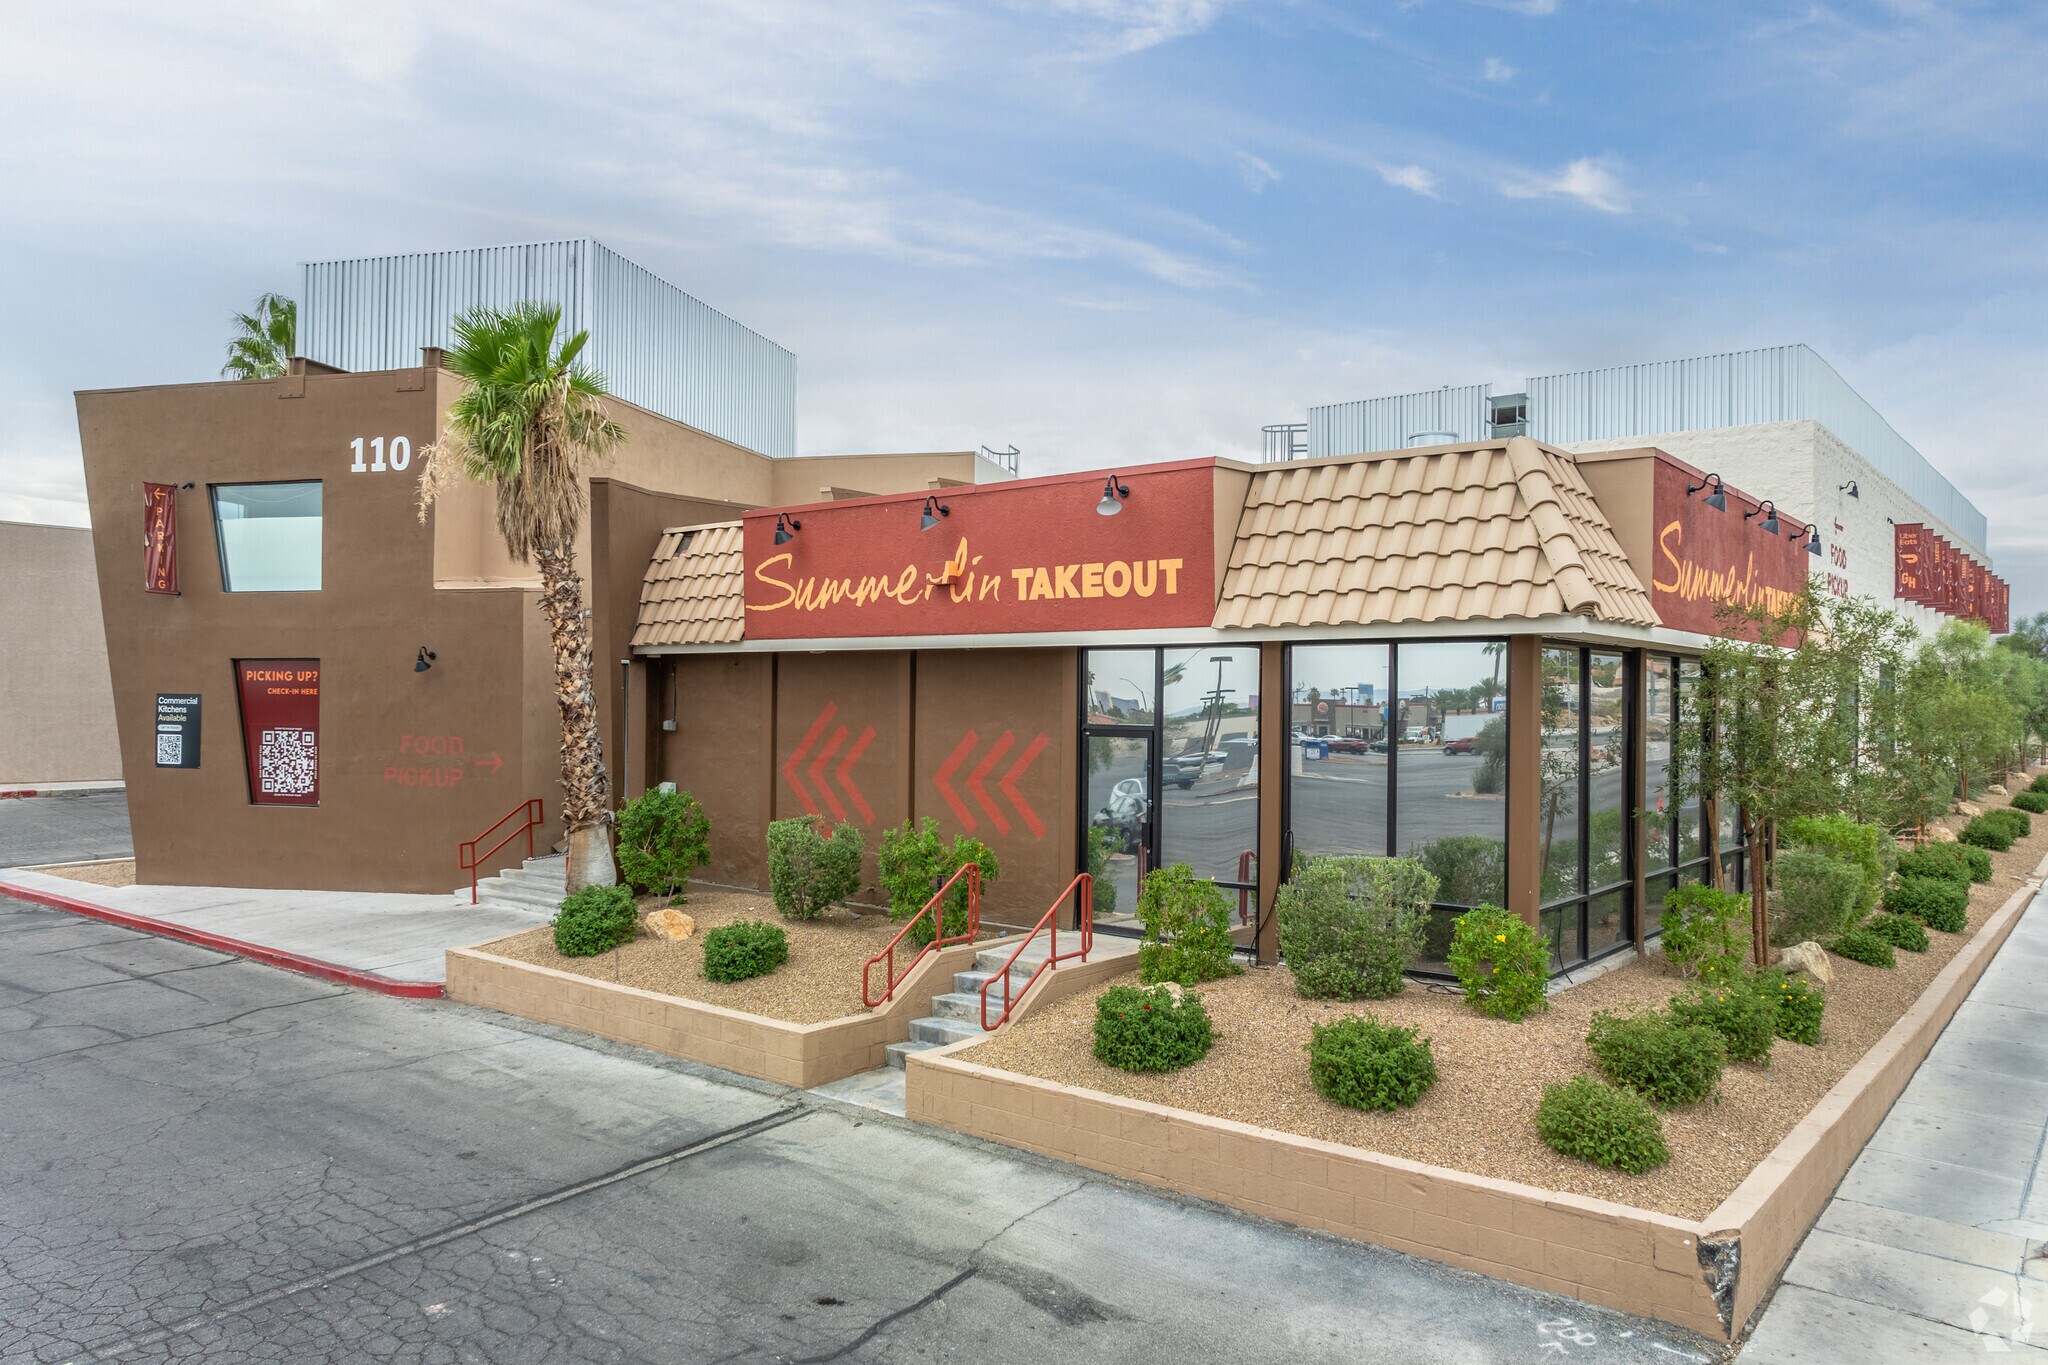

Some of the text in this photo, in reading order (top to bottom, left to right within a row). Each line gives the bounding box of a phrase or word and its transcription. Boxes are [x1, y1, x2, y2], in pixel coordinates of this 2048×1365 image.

[350, 436, 411, 473] 110
[155, 507, 167, 589] PARKING
[1831, 543, 1847, 570] FOOD
[745, 536, 1184, 612] Summerlin TAKEOUT
[1653, 520, 1766, 613] Summerlin
[1828, 572, 1848, 599] PICKUP
[246, 670, 318, 682] PICKING UP?
[158, 696, 198, 705] Commercial
[267, 687, 299, 695] CHECK-IN
[158, 705, 187, 713] Kitchens
[158, 714, 187, 722] Available
[401, 735, 464, 755] FOOD
[384, 767, 464, 787] PICKUP
